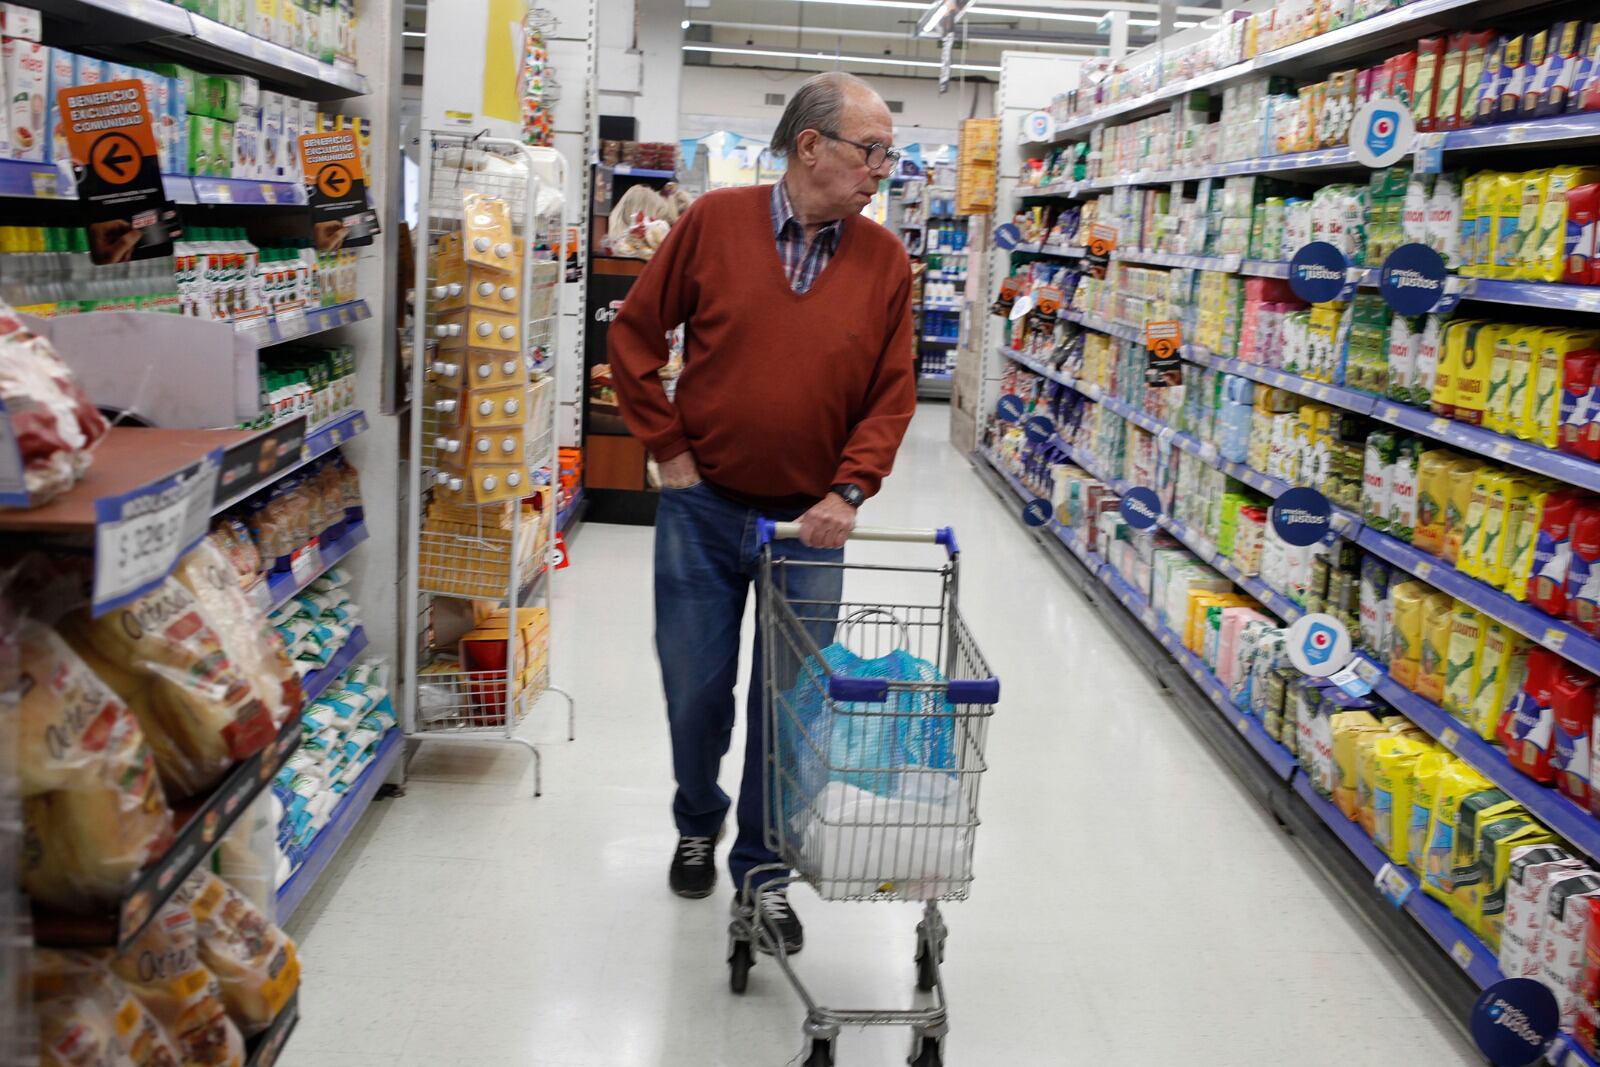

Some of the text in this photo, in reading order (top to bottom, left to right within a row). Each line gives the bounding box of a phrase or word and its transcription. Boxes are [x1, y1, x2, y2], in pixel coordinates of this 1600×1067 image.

[68, 88, 139, 108] BENEFICIO
[70, 102, 141, 121] EXCLUSIVO
[73, 115, 144, 133] COMUNIDAD
[304, 135, 353, 147] BENEFICIO
[305, 144, 354, 155] EXCLUSIVO
[306, 152, 356, 163] COMUNIDAD
[1397, 275, 1439, 290] justos
